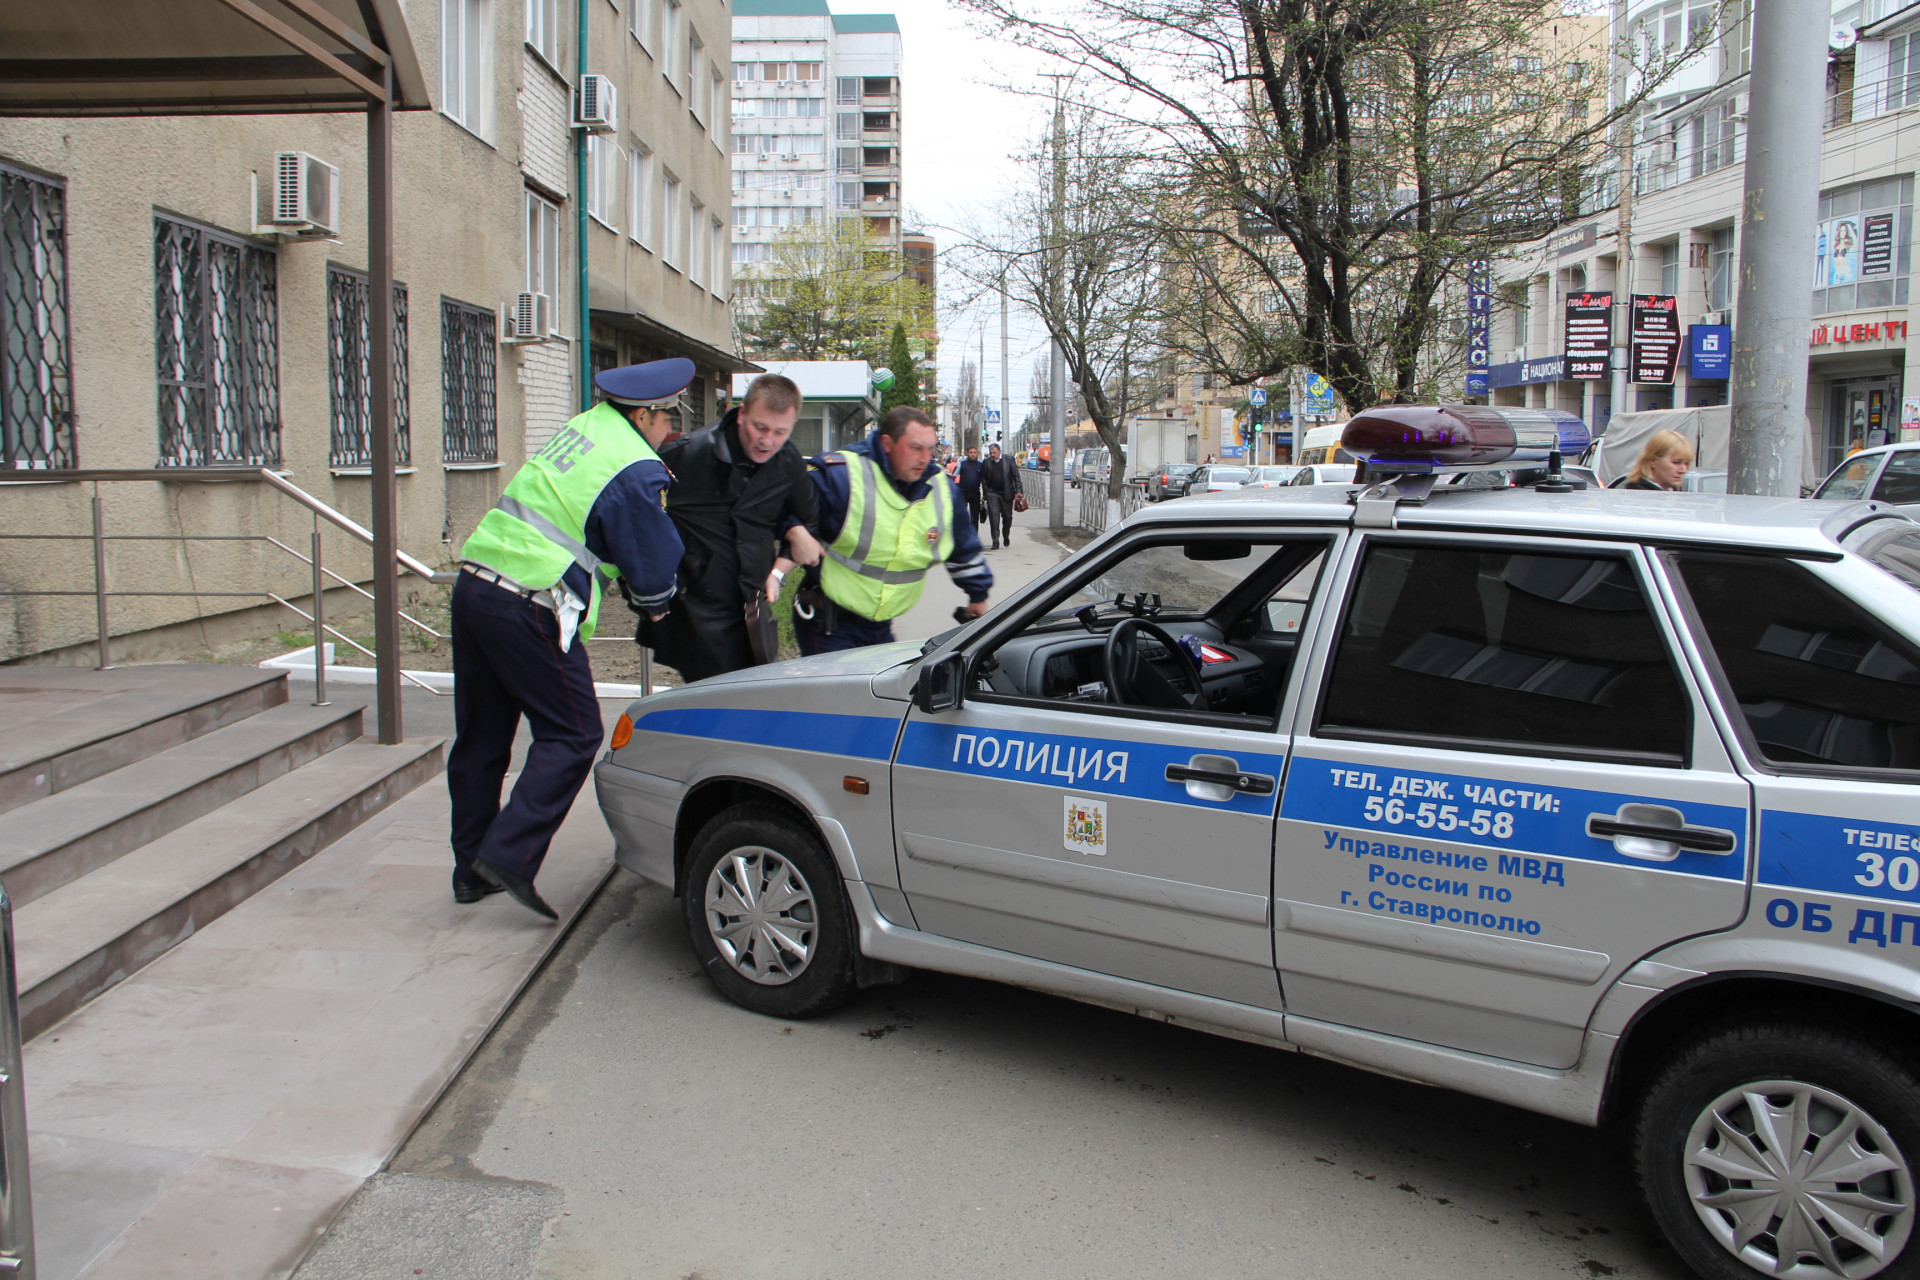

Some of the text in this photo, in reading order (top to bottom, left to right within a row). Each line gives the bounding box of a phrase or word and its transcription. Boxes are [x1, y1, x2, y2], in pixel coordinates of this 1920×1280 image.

[1571, 363, 1604, 372] 234-787
[952, 733, 1129, 784] ПОЛИЦИЯ
[1330, 768, 1561, 813] ТЕЛ. ДЕЖ. ЧАСТИ:
[1363, 795, 1514, 839] 56-55-58
[1324, 830, 1565, 887] Управление МВД
[1368, 864, 1512, 903] России по
[1340, 890, 1541, 935] г. Ставрополю
[1766, 898, 1920, 948] ОБ ДП
